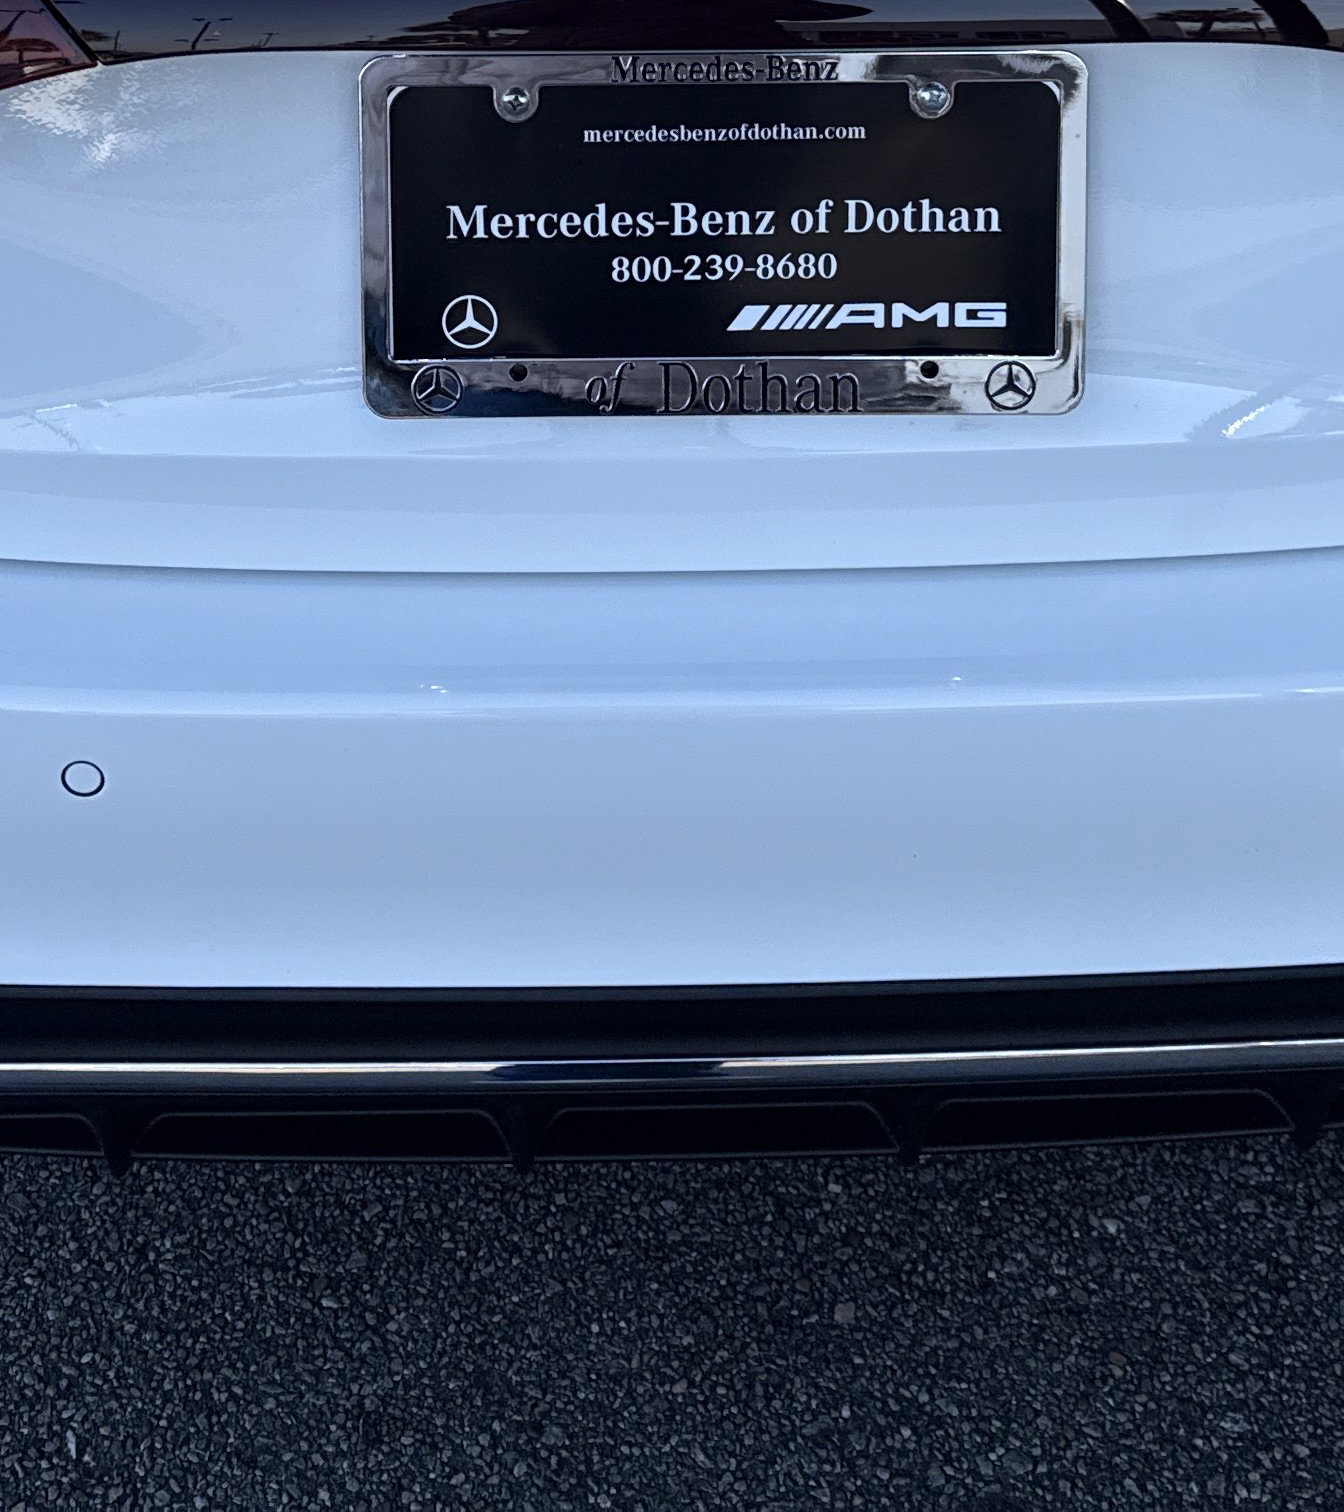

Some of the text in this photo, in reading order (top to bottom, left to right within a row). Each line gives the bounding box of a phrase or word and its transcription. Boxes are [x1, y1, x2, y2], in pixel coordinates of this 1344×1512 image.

[610, 54, 840, 84] Mercedes-Benz
[582, 122, 867, 144] mercedesbenzofdothan.com
[446, 198, 1002, 241] Mercedes-Benz of Dothan
[610, 251, 838, 283] 800-239-8680
[825, 300, 1008, 330] AMG
[584, 358, 865, 415] of Dothan
